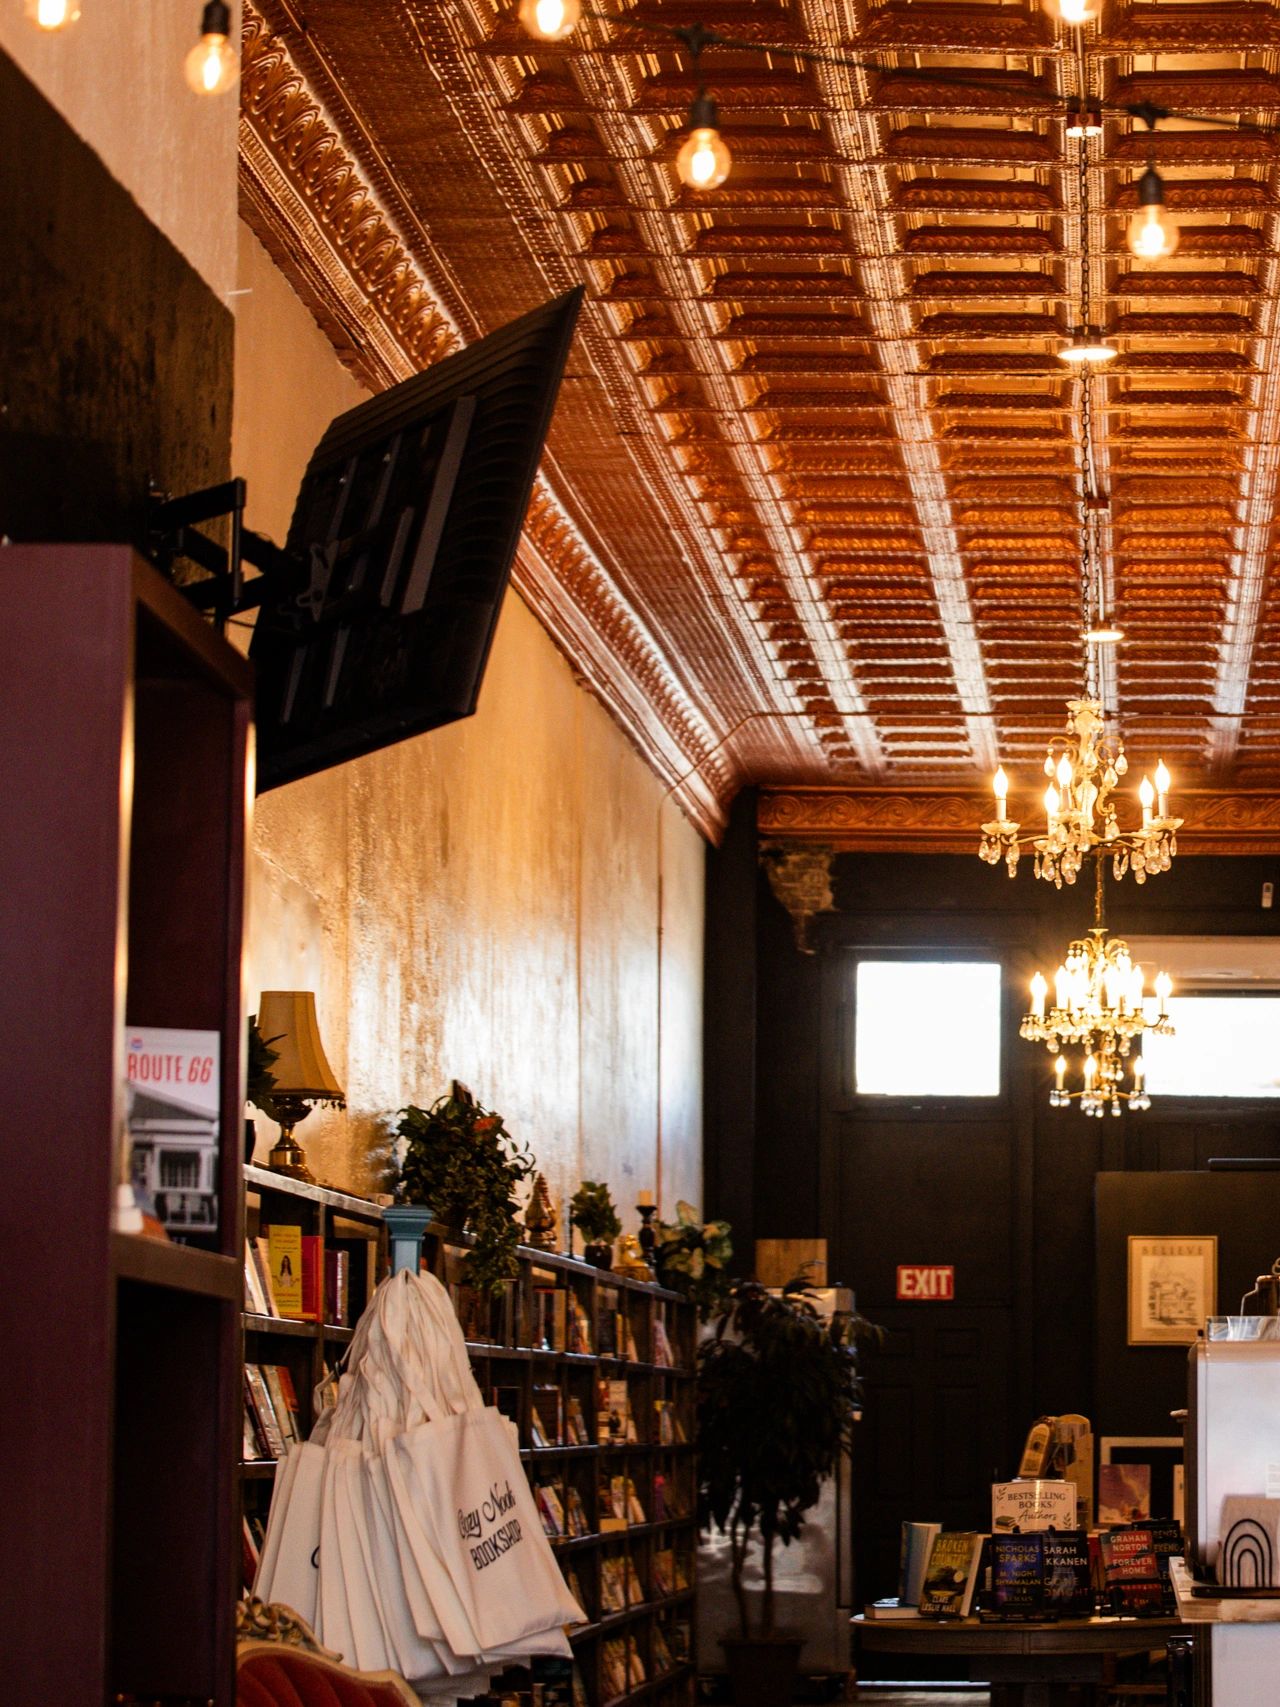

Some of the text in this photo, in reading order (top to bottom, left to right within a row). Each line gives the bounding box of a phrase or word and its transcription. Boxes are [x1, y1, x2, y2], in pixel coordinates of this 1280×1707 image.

[128, 1053, 214, 1084] ROUTE 66
[1142, 1246, 1203, 1256] BELIEVE
[901, 1268, 951, 1296] EXIT
[1008, 1491, 1066, 1501] BESTSLLING
[457, 1480, 517, 1541] Cozy Nook
[1019, 1508, 1057, 1522] Authors
[1110, 1534, 1148, 1543] GRAHAM
[469, 1519, 523, 1571] BOOKSHOP
[995, 1545, 1040, 1553] NICHOLAS
[1112, 1543, 1149, 1552] NORTON
[1043, 1546, 1077, 1555] SARAH
[999, 1554, 1037, 1563] SPARKS
[1044, 1557, 1088, 1566] KKANEN
[1112, 1557, 1153, 1567] FOREVER
[1011, 1569, 1036, 1577] NIGHT
[1122, 1566, 1147, 1575] HOME
